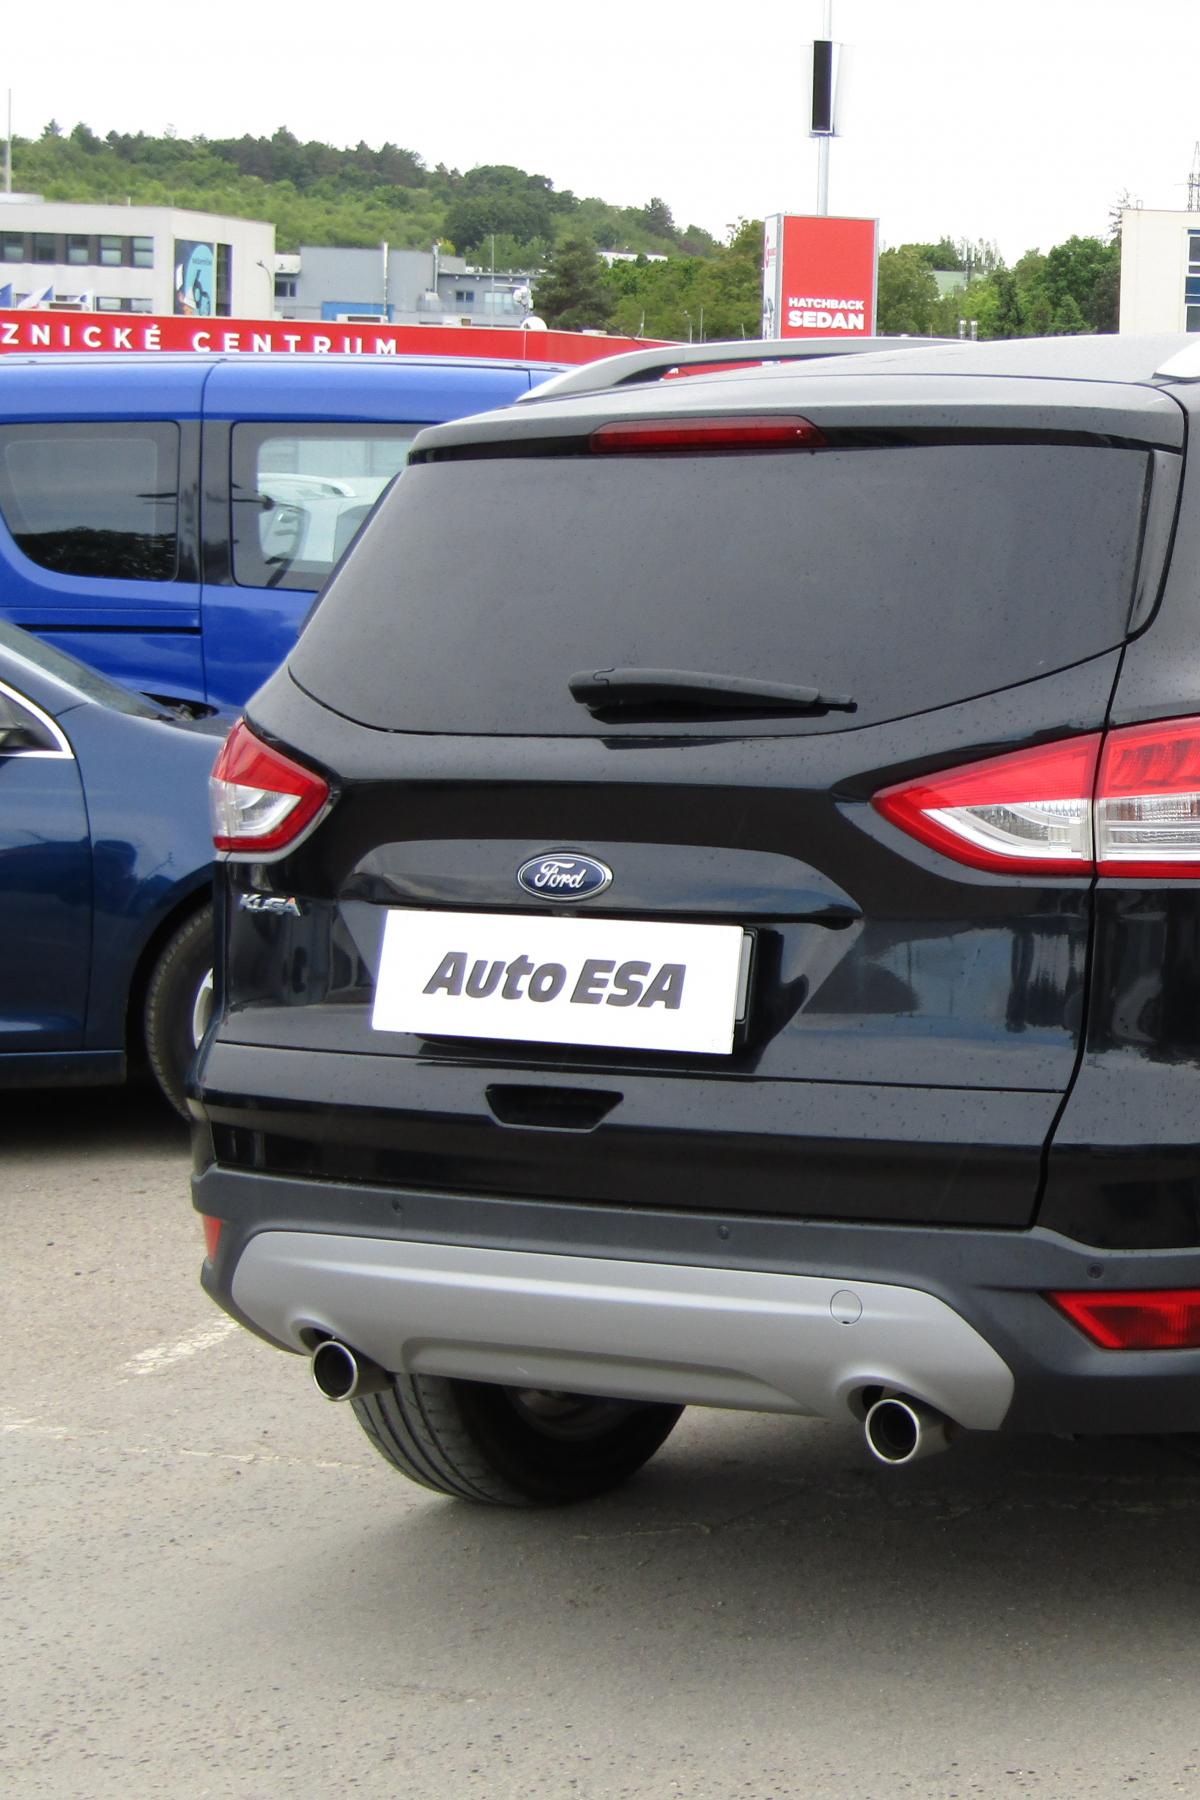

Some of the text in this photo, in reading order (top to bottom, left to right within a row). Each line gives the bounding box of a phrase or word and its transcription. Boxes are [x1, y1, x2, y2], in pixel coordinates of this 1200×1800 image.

[787, 297, 864, 310] HATCHBACK
[787, 311, 864, 330] SEDAN
[192, 331, 397, 355] CENTRUM
[534, 861, 587, 888] Ford
[239, 893, 301, 917] KUGA
[422, 951, 687, 1010] Auto ESA
